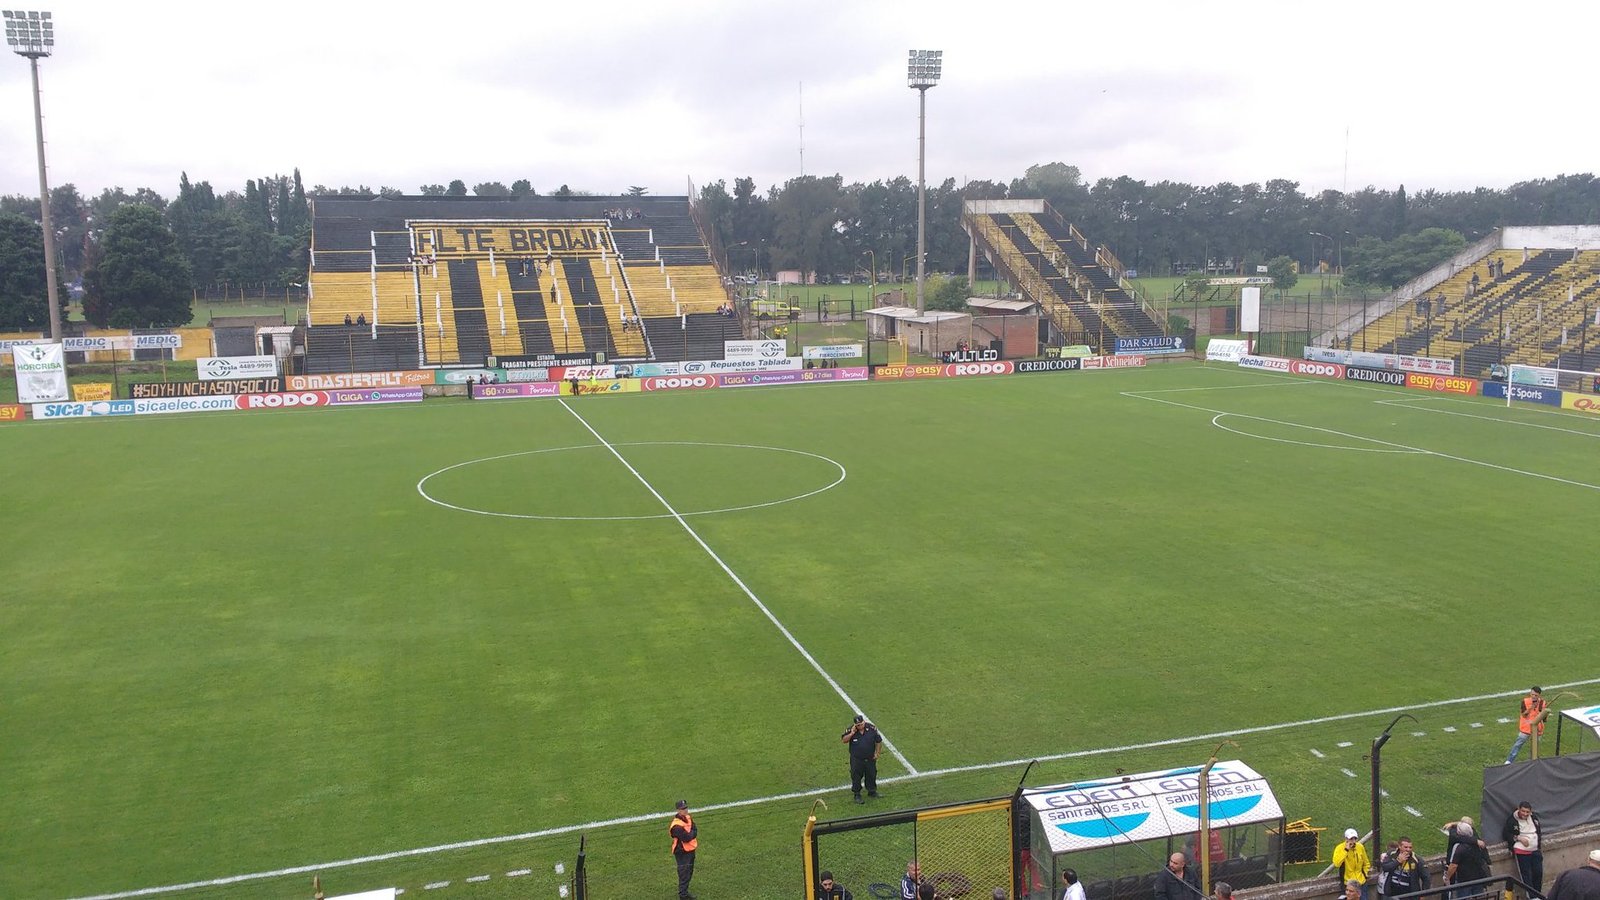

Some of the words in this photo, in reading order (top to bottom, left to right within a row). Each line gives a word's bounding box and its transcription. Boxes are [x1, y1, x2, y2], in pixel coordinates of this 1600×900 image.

[509, 228, 610, 251] BROWN
[0, 341, 33, 350] EDIC
[65, 338, 106, 347] MEDIC
[137, 335, 177, 344] MEDIC
[1120, 339, 1140, 348] DAR
[1142, 337, 1172, 347] SALUD
[950, 349, 998, 362] MULTILED
[1105, 355, 1144, 367] Schneider
[17, 362, 62, 371] HORCRISA
[502, 361, 526, 369] FRAGATA
[527, 360, 560, 368] PRESIDENTE
[710, 361, 756, 370] Repuestos
[758, 359, 792, 367] Tablada
[915, 365, 942, 376] easy
[956, 363, 1006, 376] RODO
[1019, 359, 1077, 372] CREDICOOP
[1298, 363, 1336, 376] RODO
[878, 367, 905, 377] easy
[1347, 367, 1405, 385] CREDICOOP
[308, 371, 404, 389] MASTERFILT
[655, 377, 707, 389] RODO
[1409, 375, 1435, 388] easy
[1446, 379, 1472, 393] easy
[482, 387, 496, 396] $60
[610, 382, 621, 391] 6
[249, 392, 319, 408] RODO
[1517, 388, 1543, 400] Sports
[111, 404, 132, 413] LED
[137, 398, 233, 412] sicaelec.com
[1045, 785, 1139, 808] EDEN
